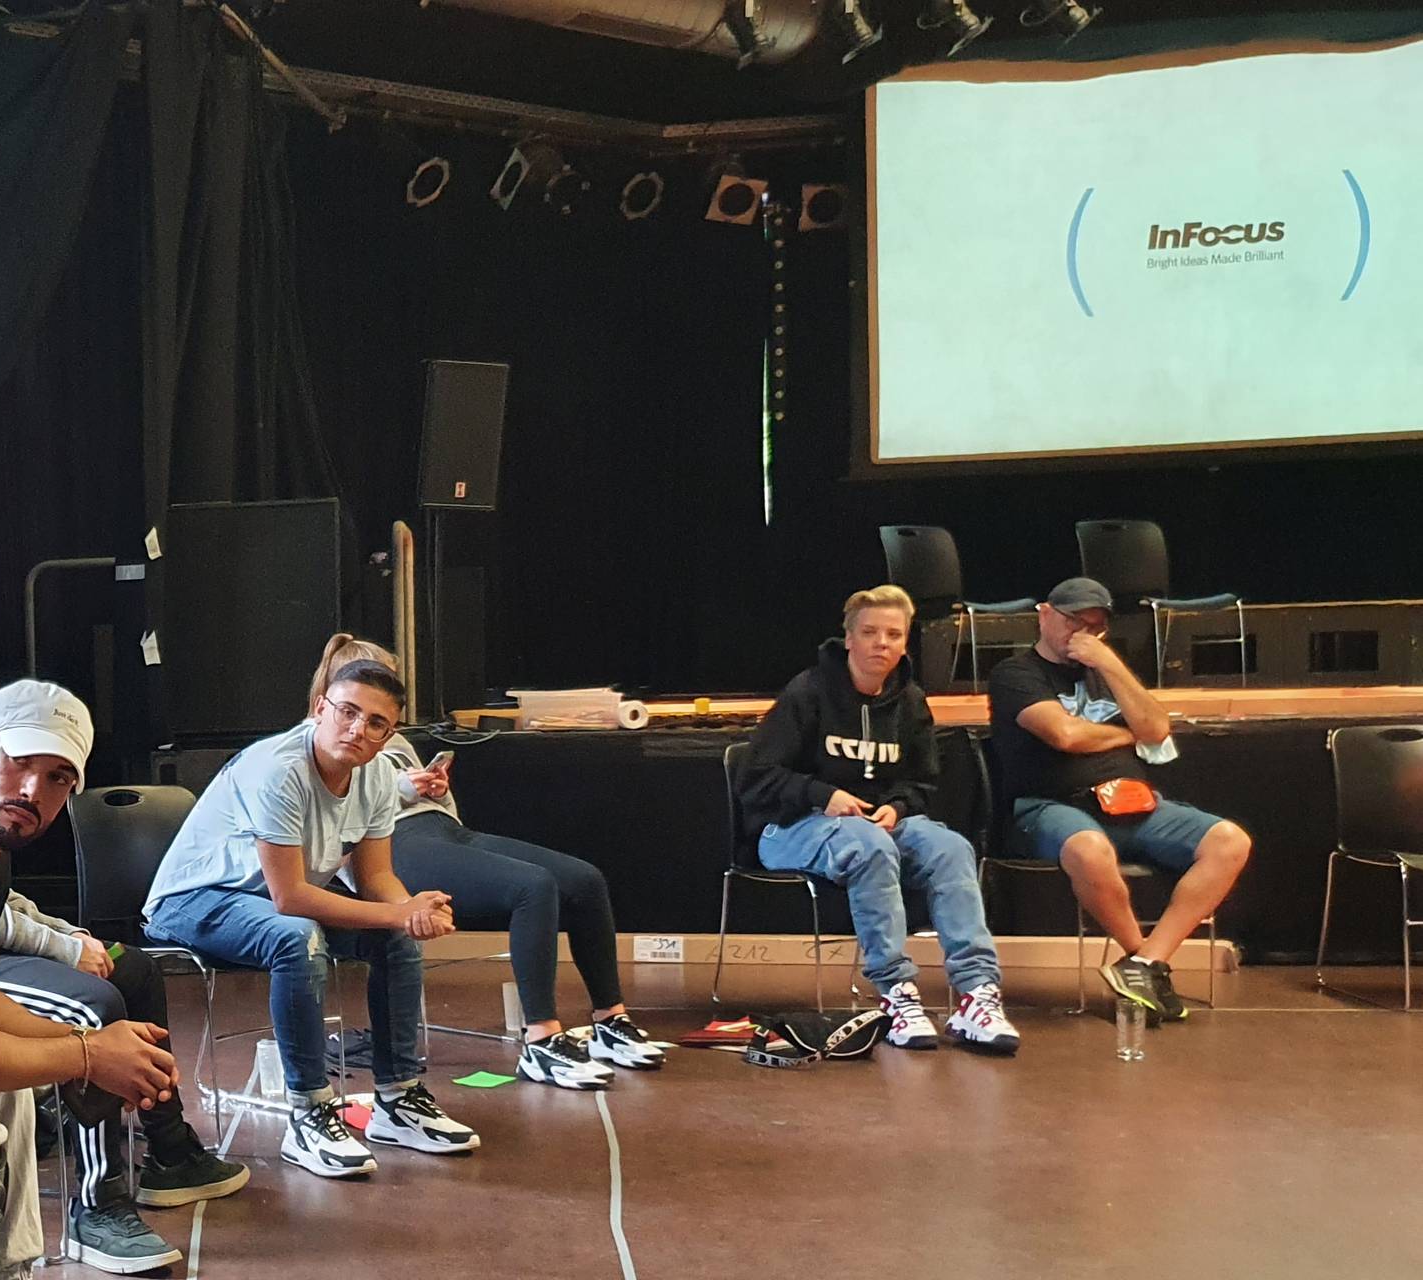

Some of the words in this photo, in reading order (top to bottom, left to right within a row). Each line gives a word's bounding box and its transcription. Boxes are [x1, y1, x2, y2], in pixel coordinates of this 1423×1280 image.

[1147, 221, 1285, 250] InFocus
[1147, 258, 1178, 270] Bright
[1180, 256, 1209, 267] Ideas
[1211, 254, 1242, 265] Made
[1244, 250, 1284, 262] Brilliant
